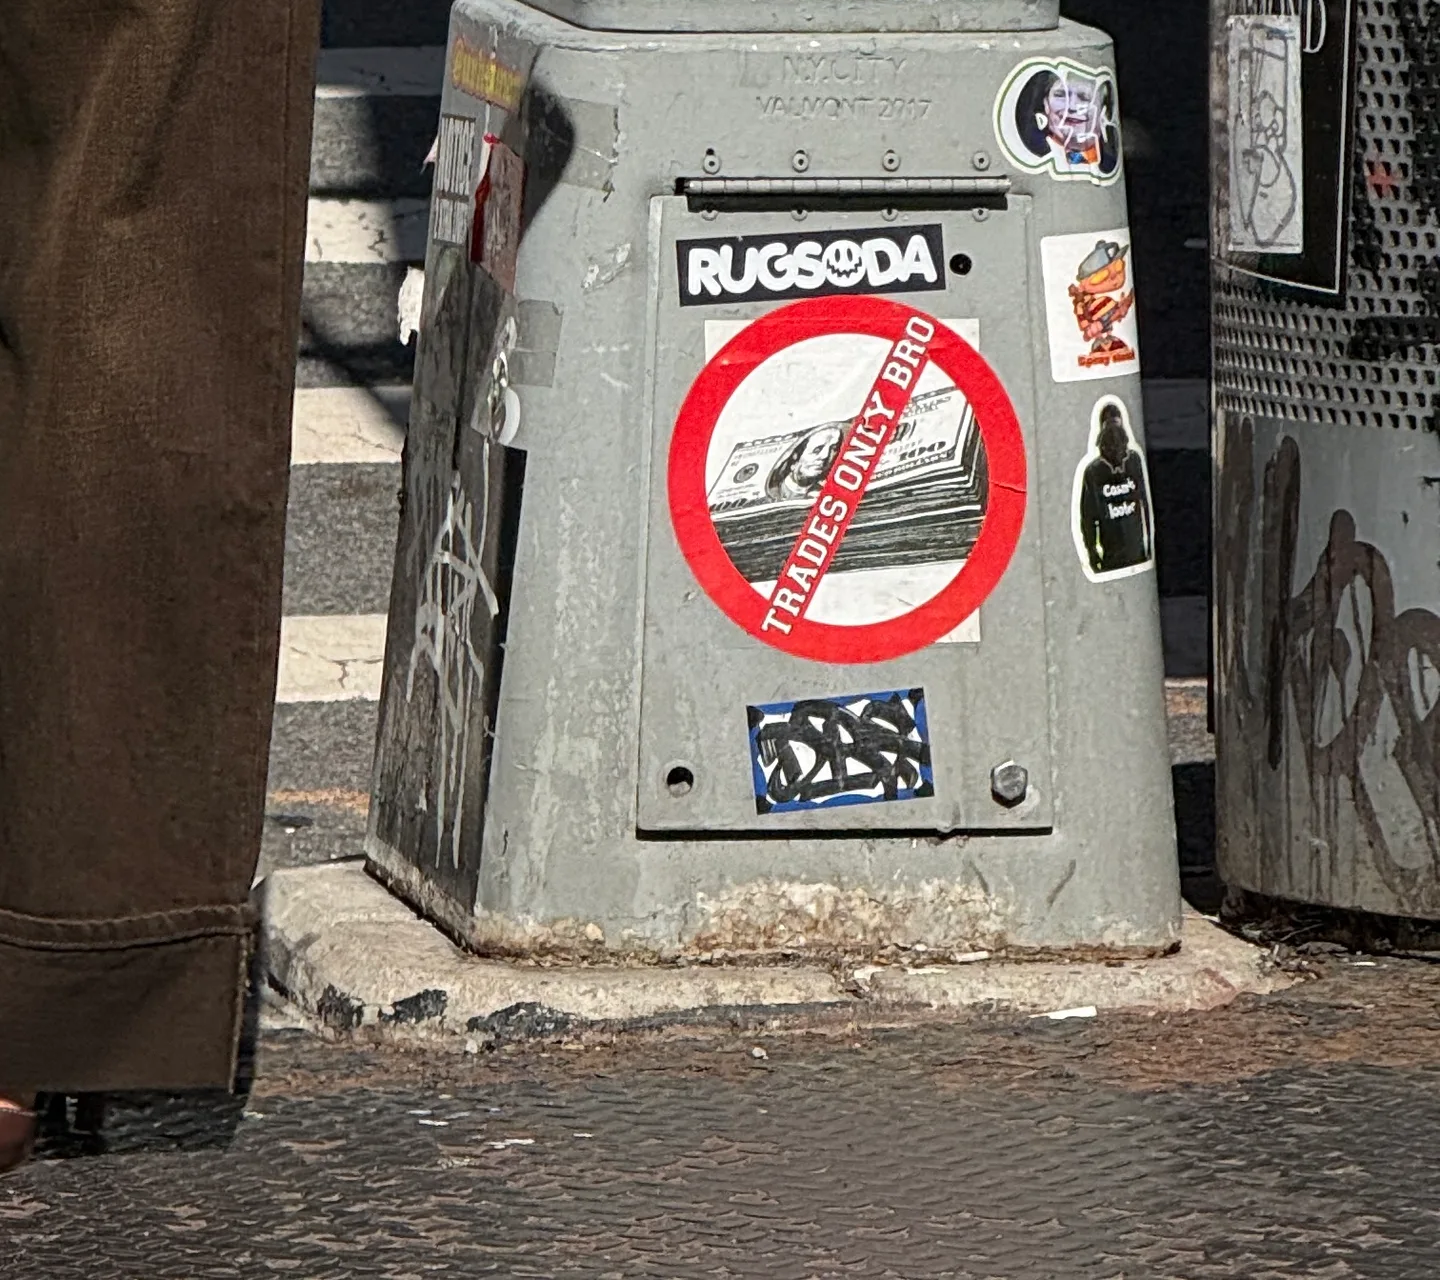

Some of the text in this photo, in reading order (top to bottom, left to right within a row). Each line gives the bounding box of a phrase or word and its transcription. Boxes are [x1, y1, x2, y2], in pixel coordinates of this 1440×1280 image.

[755, 95, 874, 120] VALMONT
[687, 234, 938, 297] RUGSODA
[761, 314, 936, 636] TRADES ONLY BRO
